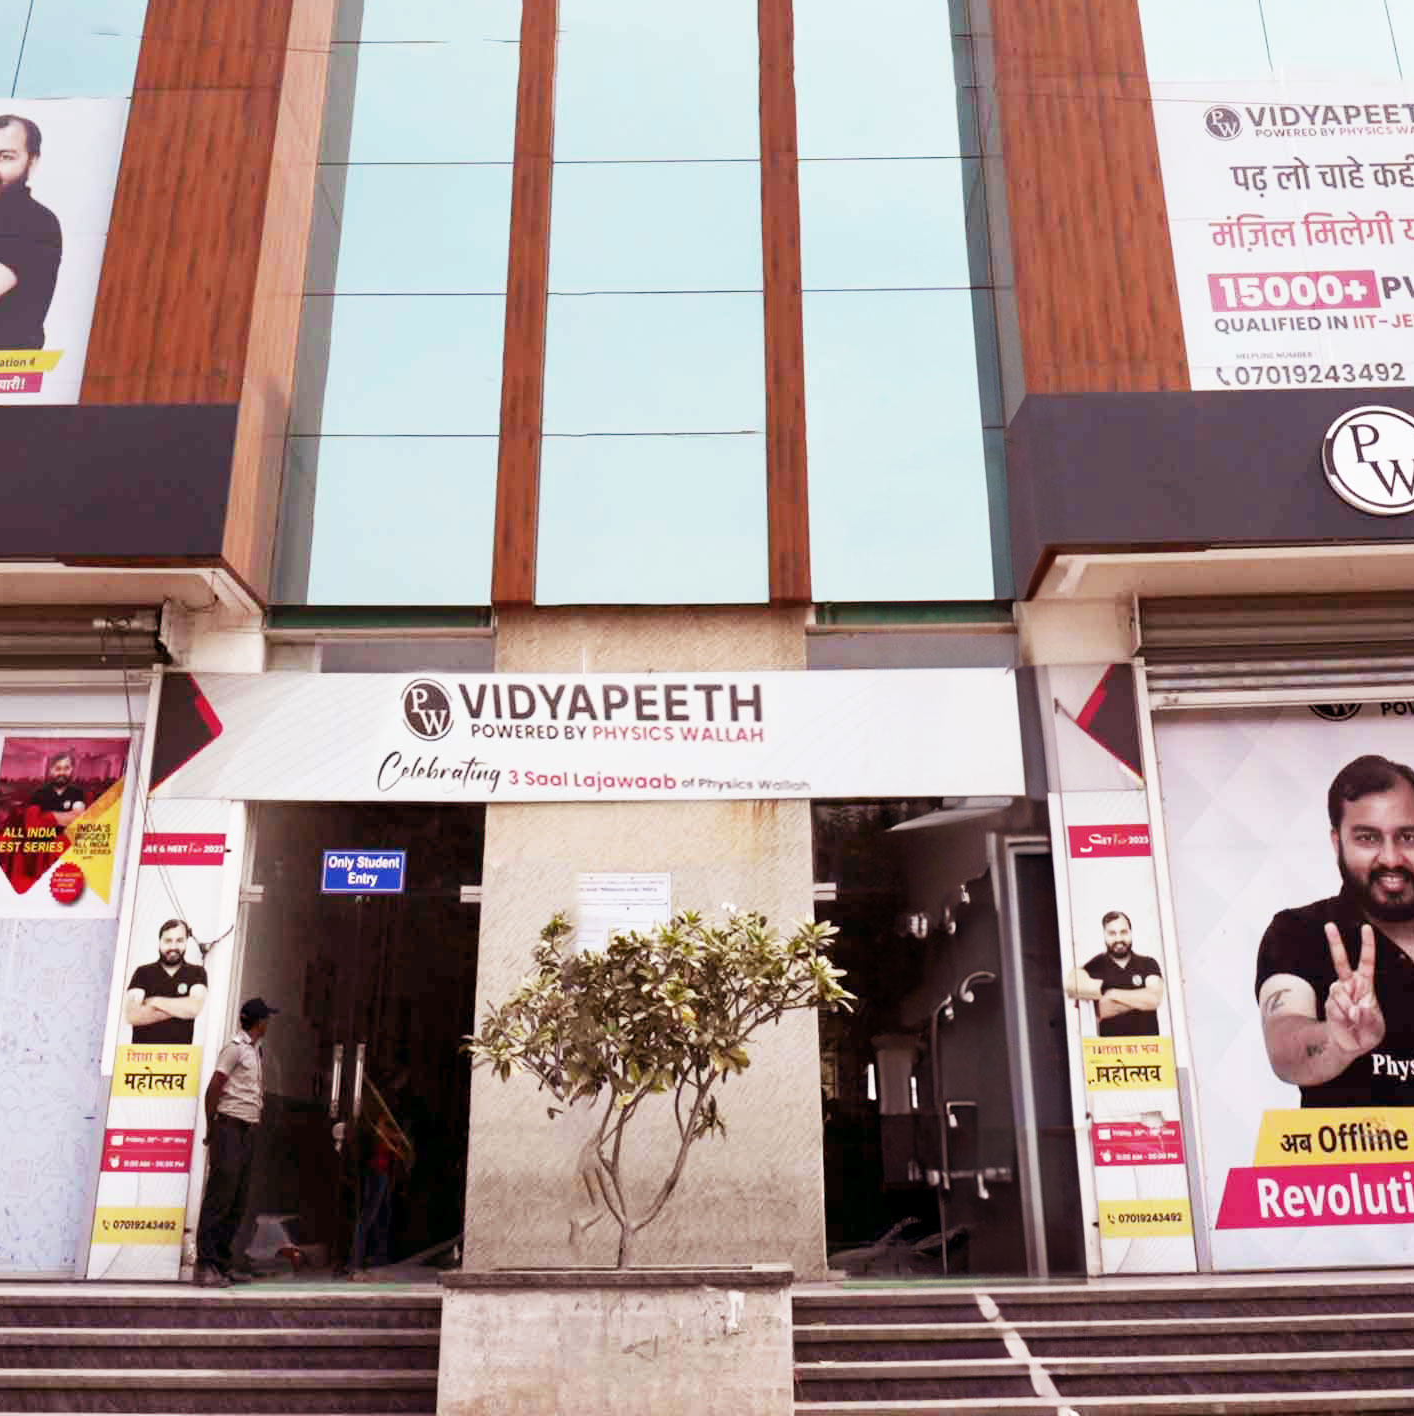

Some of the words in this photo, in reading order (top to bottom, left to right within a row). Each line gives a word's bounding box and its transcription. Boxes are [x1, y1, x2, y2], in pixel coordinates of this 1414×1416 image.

[1255, 128, 1317, 138] POWERED
[1320, 127, 1336, 137] BY
[1339, 126, 1393, 137] PHYSICS
[1230, 166, 1268, 198] पढ़
[1273, 157, 1310, 190] लो
[1315, 156, 1364, 189] चाहे
[1301, 210, 1394, 246] मिलेगी
[1219, 274, 1368, 309] 15000+
[1214, 316, 1321, 334] QUALIFIED
[1327, 316, 1347, 331] IN
[1235, 362, 1406, 386] 07019243492
[458, 684, 762, 722] VIDYAPEETH
[471, 724, 559, 740] POWERED
[565, 725, 587, 740] BY
[593, 725, 674, 741] PHYSICS
[679, 726, 764, 742] WALLAH
[377, 750, 500, 793] Celebrating
[508, 770, 519, 785] 3
[525, 770, 567, 786] Saal
[574, 771, 676, 791] Lajawaab
[681, 778, 695, 789] of
[698, 778, 753, 791] Physics
[758, 780, 811, 790] Wallah
[3, 827, 24, 837] ALL
[27, 827, 57, 838] INDIA
[23, 841, 63, 853] SERIES
[328, 856, 354, 871] Only
[356, 856, 400, 868] Student
[348, 872, 378, 887] Entry
[125, 1067, 187, 1092] महोत्सव
[1280, 1134, 1312, 1155] अब
[1318, 1123, 1408, 1153] Offline
